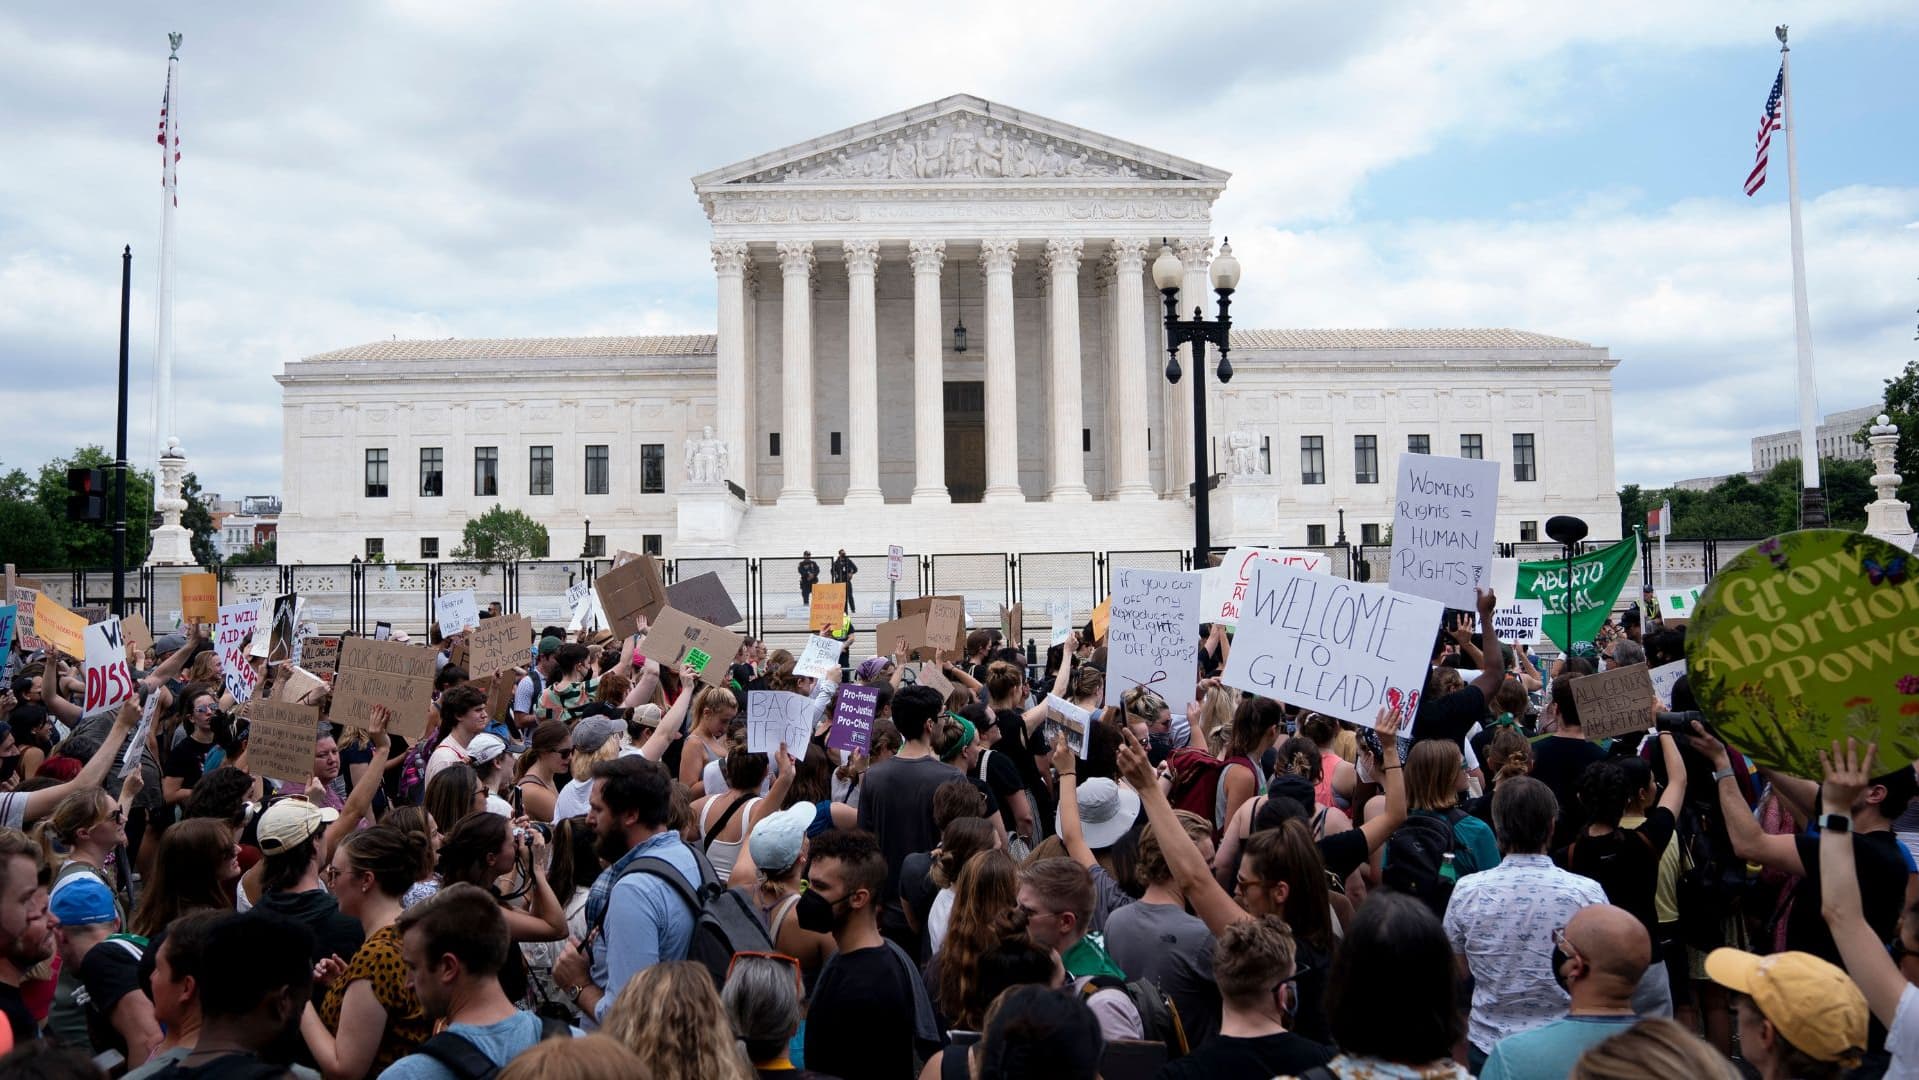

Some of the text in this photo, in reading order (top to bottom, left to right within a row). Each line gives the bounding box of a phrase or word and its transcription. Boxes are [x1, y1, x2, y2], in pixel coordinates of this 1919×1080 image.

[1398, 500, 1450, 520] Rights
[1411, 526, 1479, 550] HUMAN
[1530, 561, 1603, 592] ABORTO
[1722, 545, 1864, 622] Grow
[1142, 579, 1167, 596] you
[1540, 588, 1604, 615] LEGAL
[235, 610, 258, 624] WILL
[1255, 569, 1413, 662] WELCOME
[1495, 616, 1539, 627] AND ABET
[219, 628, 239, 645] AID
[475, 627, 520, 648] SHAME
[1495, 629, 1533, 639] ORTION
[348, 648, 371, 669] OUR
[1288, 635, 1331, 667] TO
[473, 659, 498, 675] YOU
[1576, 683, 1603, 705] ALL
[1598, 695, 1632, 713] NEED
[752, 691, 811, 731] BACK
[749, 720, 805, 749] TF OFF
